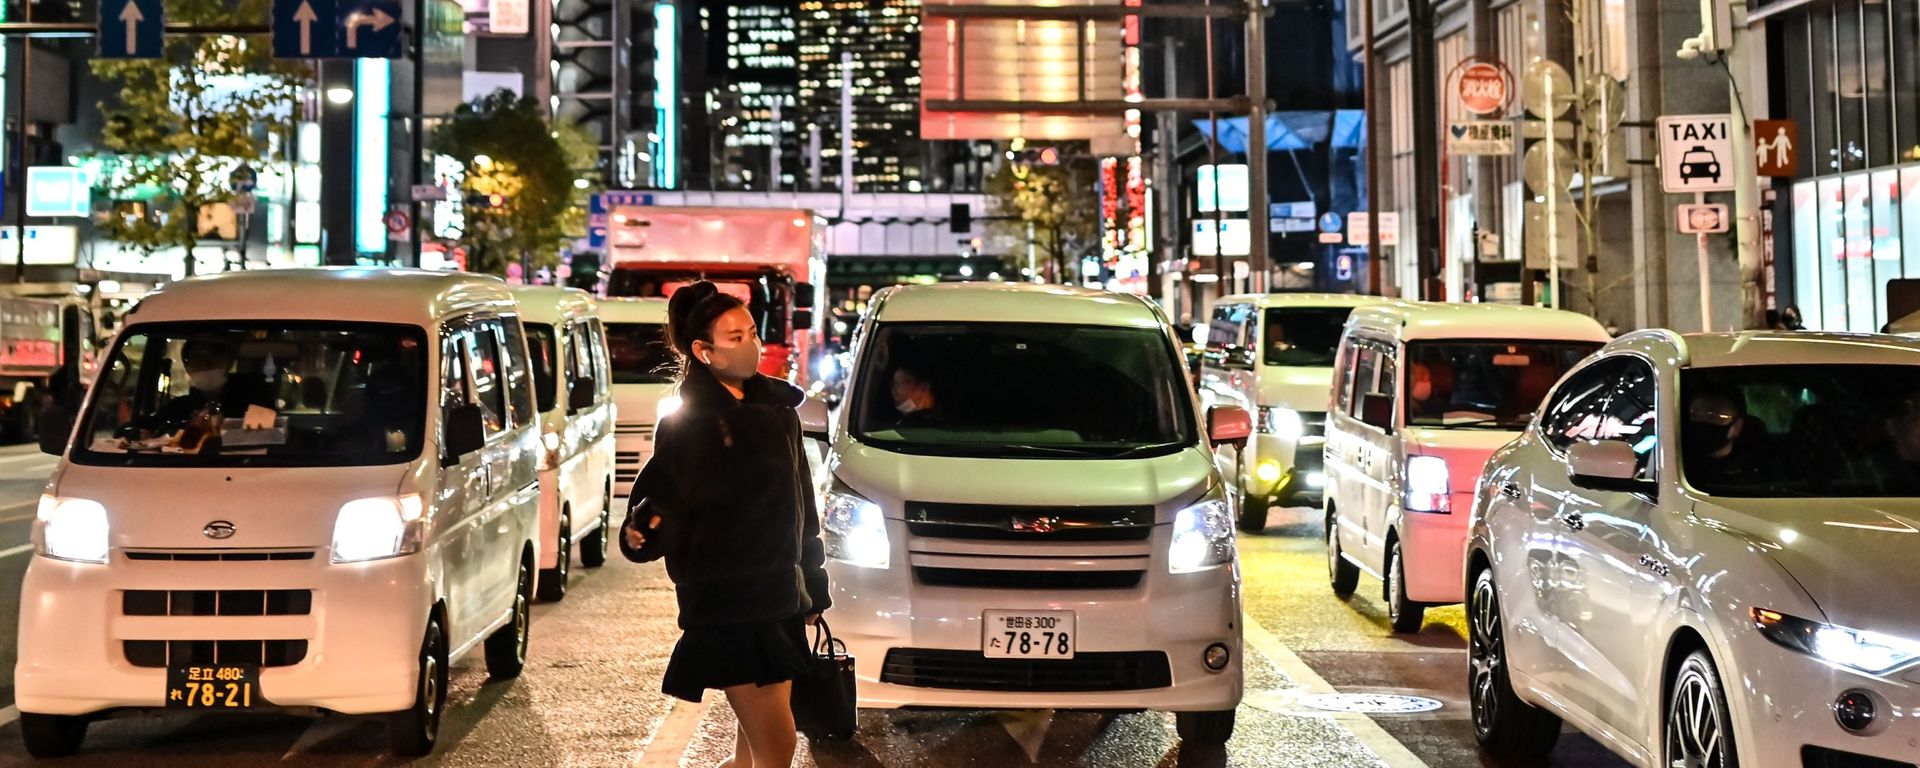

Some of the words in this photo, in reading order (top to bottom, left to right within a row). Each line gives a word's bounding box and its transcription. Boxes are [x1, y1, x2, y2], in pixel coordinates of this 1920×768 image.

[1668, 122, 1727, 141] TAXI
[990, 637, 1001, 648] た
[1004, 631, 1069, 655] 78-78
[170, 688, 183, 701] れ
[185, 682, 251, 707] 78-21
